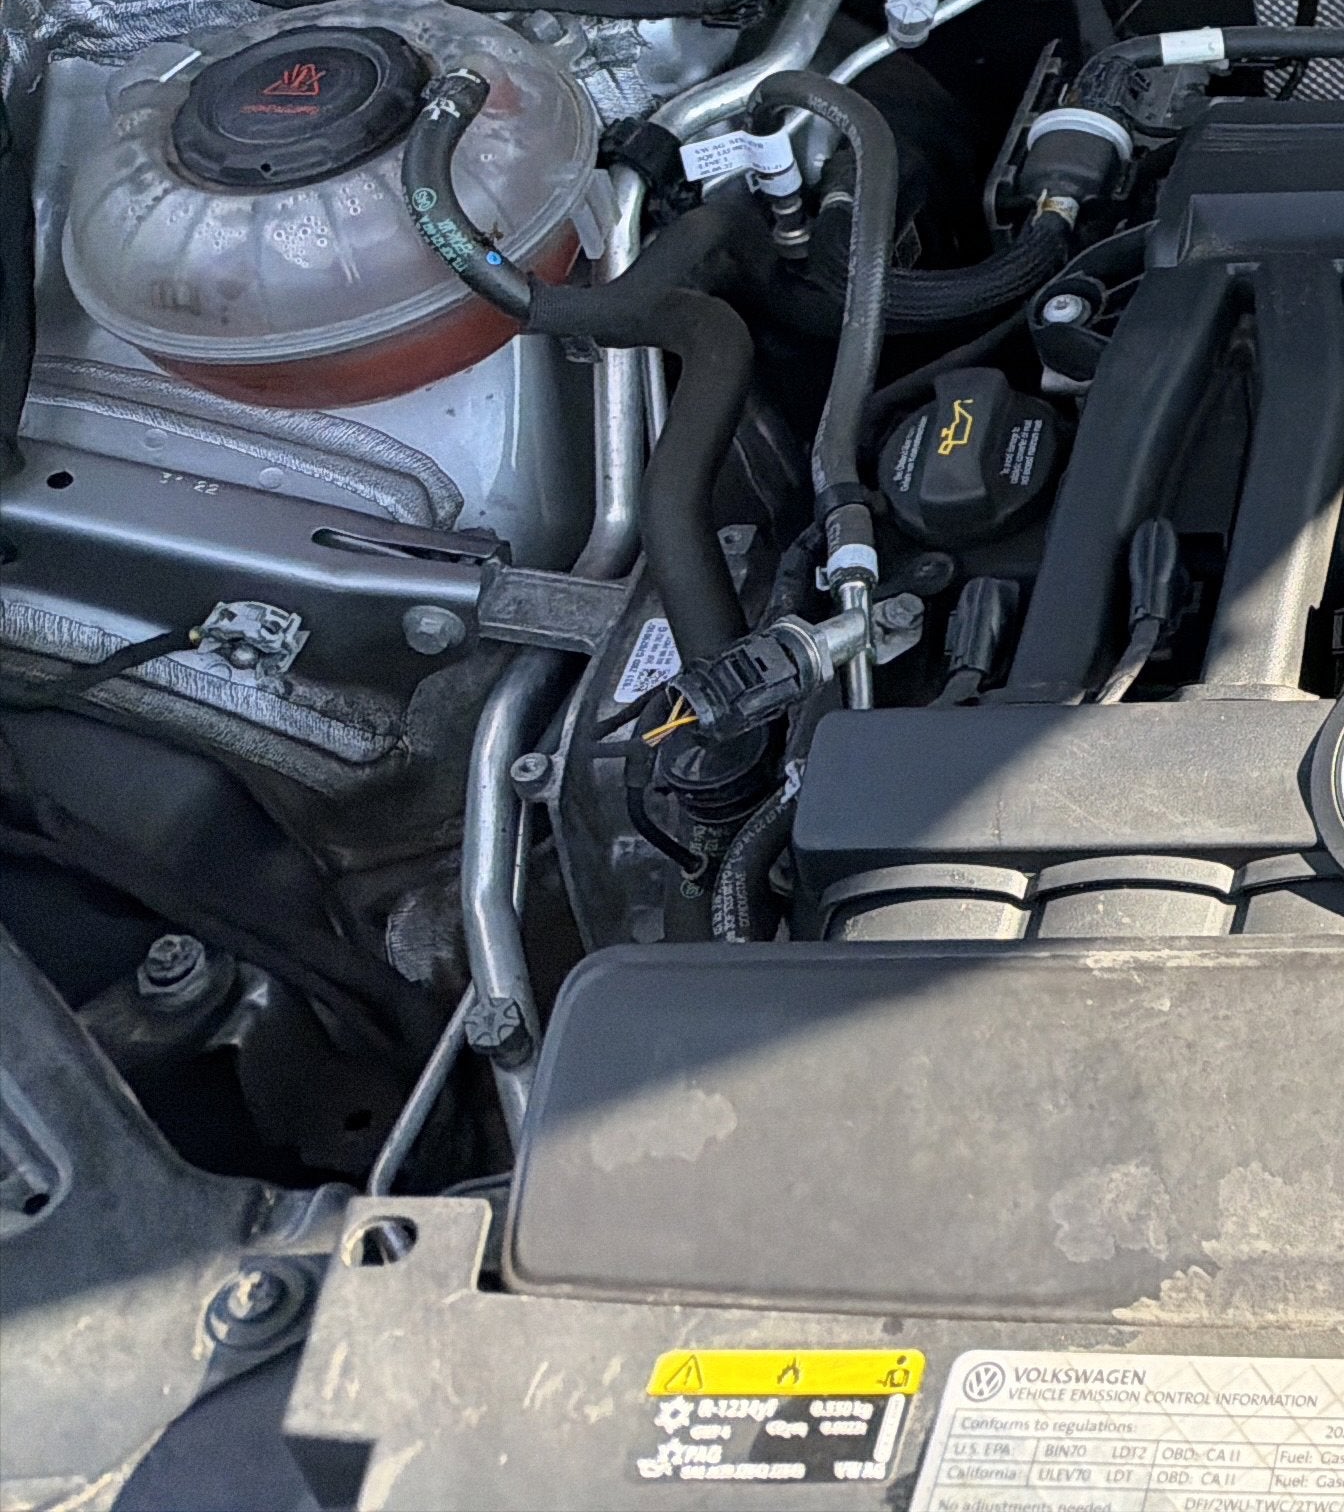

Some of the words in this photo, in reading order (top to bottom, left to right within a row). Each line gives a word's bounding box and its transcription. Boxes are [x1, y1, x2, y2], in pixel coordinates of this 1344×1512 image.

[1014, 1366, 1147, 1386] VOLKSWAGEN
[1008, 1387, 1066, 1401] VEHICLE
[1070, 1388, 1141, 1403] EMISSION
[1144, 1390, 1212, 1406] CONTROL
[1216, 1392, 1318, 1408] INFORMATION
[961, 1416, 1029, 1432] Conforms
[1034, 1419, 1049, 1432] to
[1044, 1444, 1087, 1457] BIN70
[1112, 1445, 1147, 1460] LDT2
[1161, 1446, 1198, 1461] OBD:
[1206, 1448, 1225, 1462] CA
[1279, 1451, 1312, 1465] Fuel:
[1038, 1467, 1092, 1482] ULEV70
[1105, 1469, 1134, 1483] LDT
[1156, 1471, 1193, 1484] OBD:
[1201, 1472, 1220, 1486] CA
[1274, 1474, 1308, 1488] Fuel:
[938, 1498, 958, 1511] No
[962, 1498, 1052, 1512] adjustments
